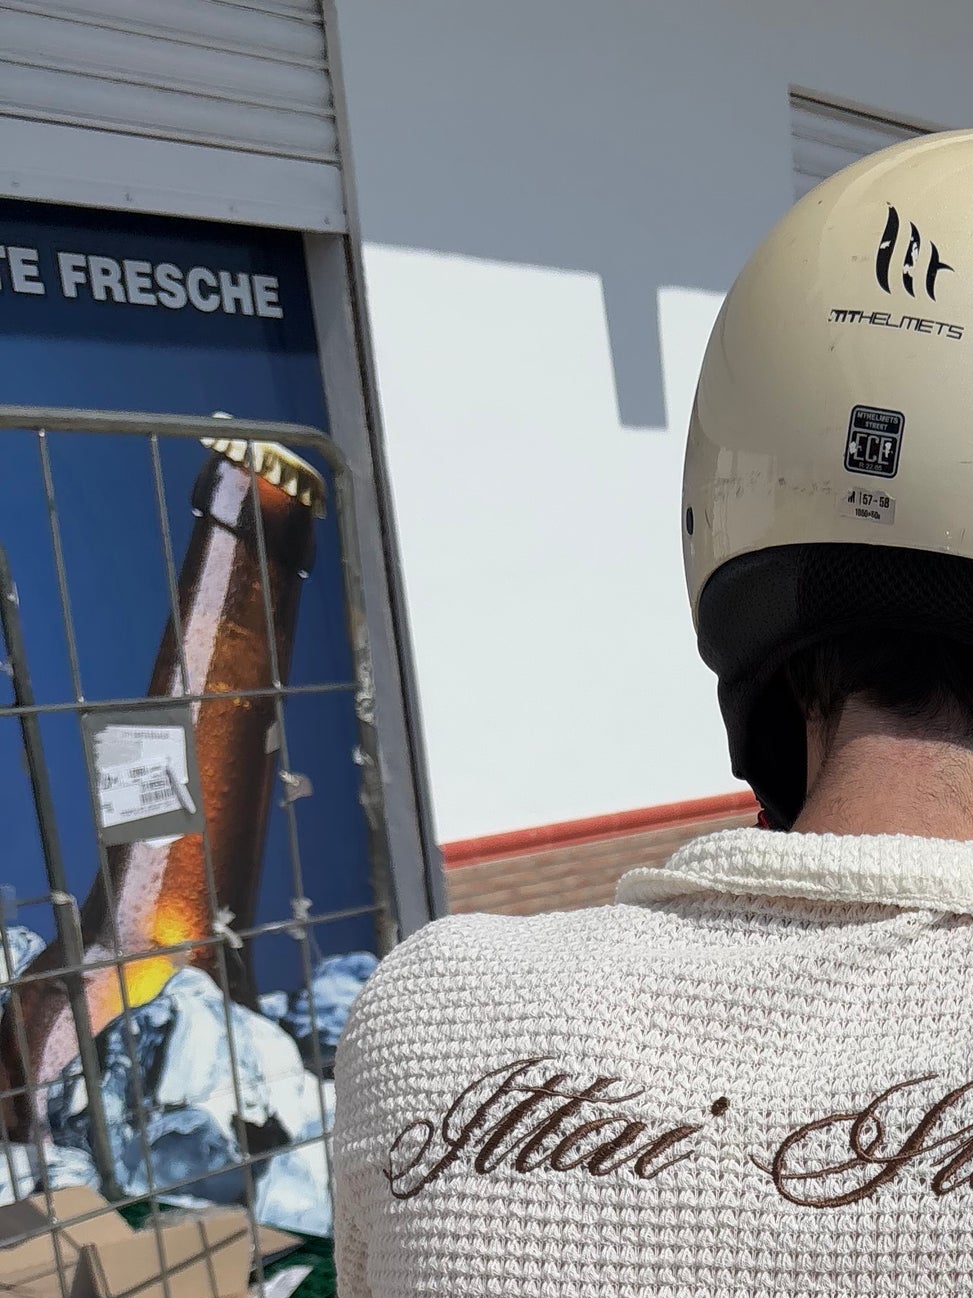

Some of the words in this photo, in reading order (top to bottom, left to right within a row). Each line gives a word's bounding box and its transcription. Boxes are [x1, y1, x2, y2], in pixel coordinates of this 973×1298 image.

[0, 245, 46, 295] E
[57, 252, 284, 319] FRESCHE
[853, 432, 893, 465] ECE
